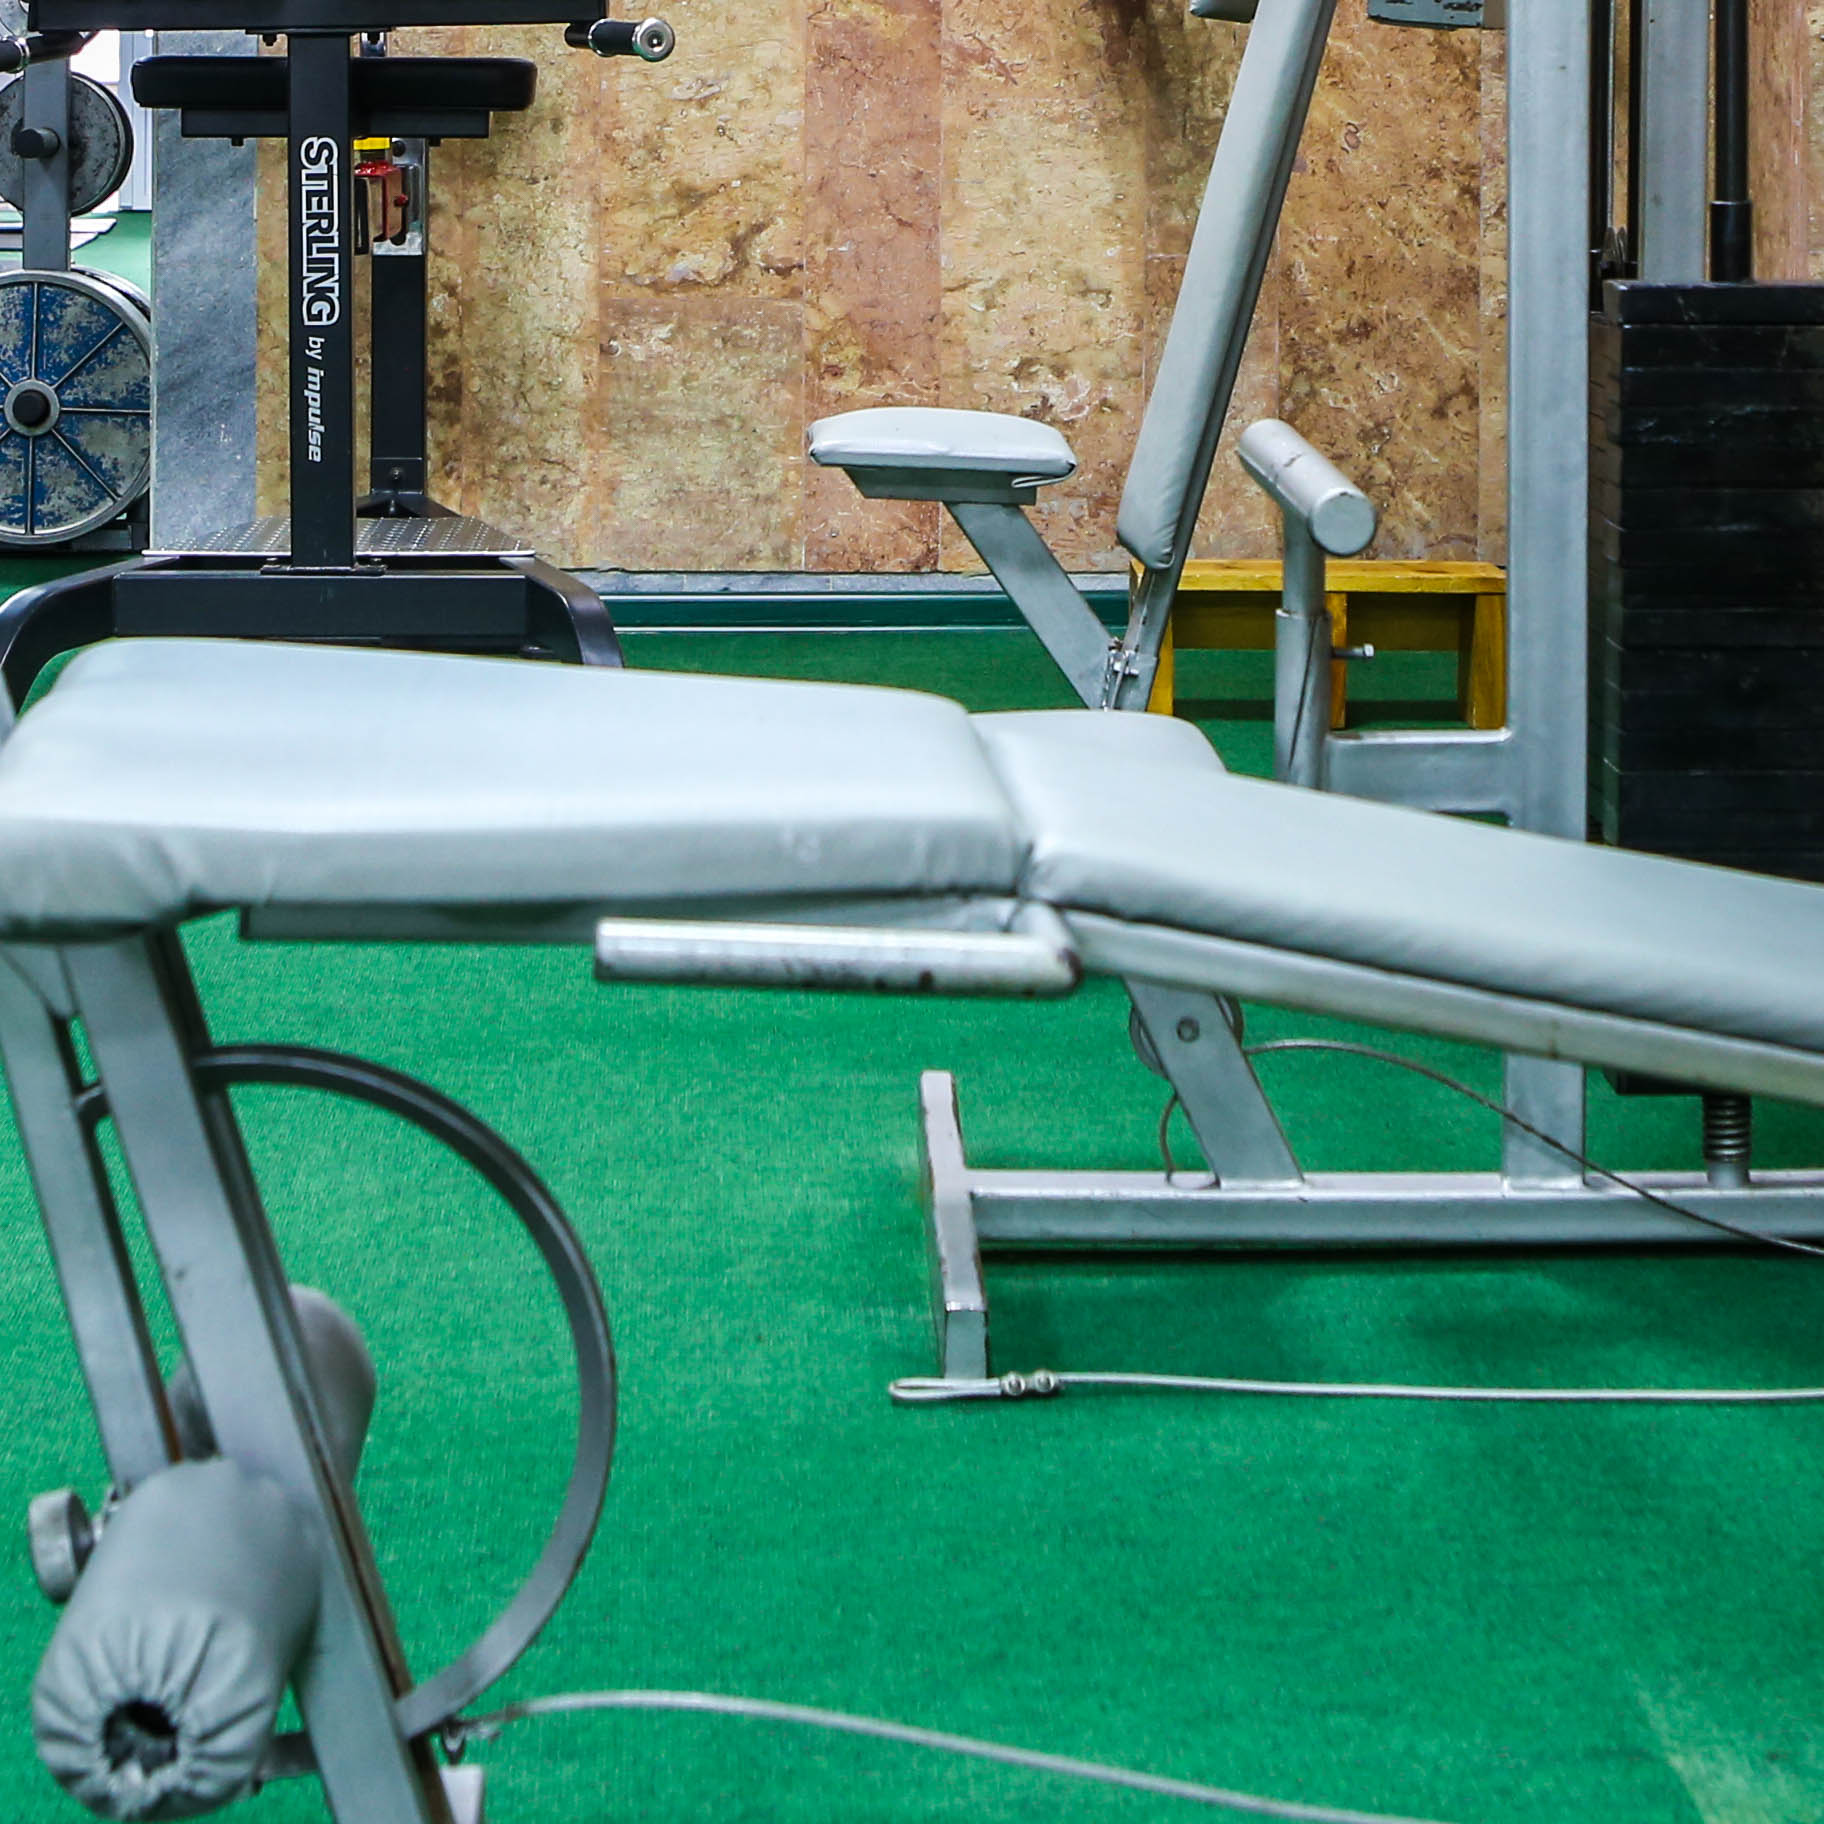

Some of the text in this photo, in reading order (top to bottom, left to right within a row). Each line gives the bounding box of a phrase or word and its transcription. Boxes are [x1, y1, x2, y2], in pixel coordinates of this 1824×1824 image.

[300, 137, 340, 463] STERLING by impulse
